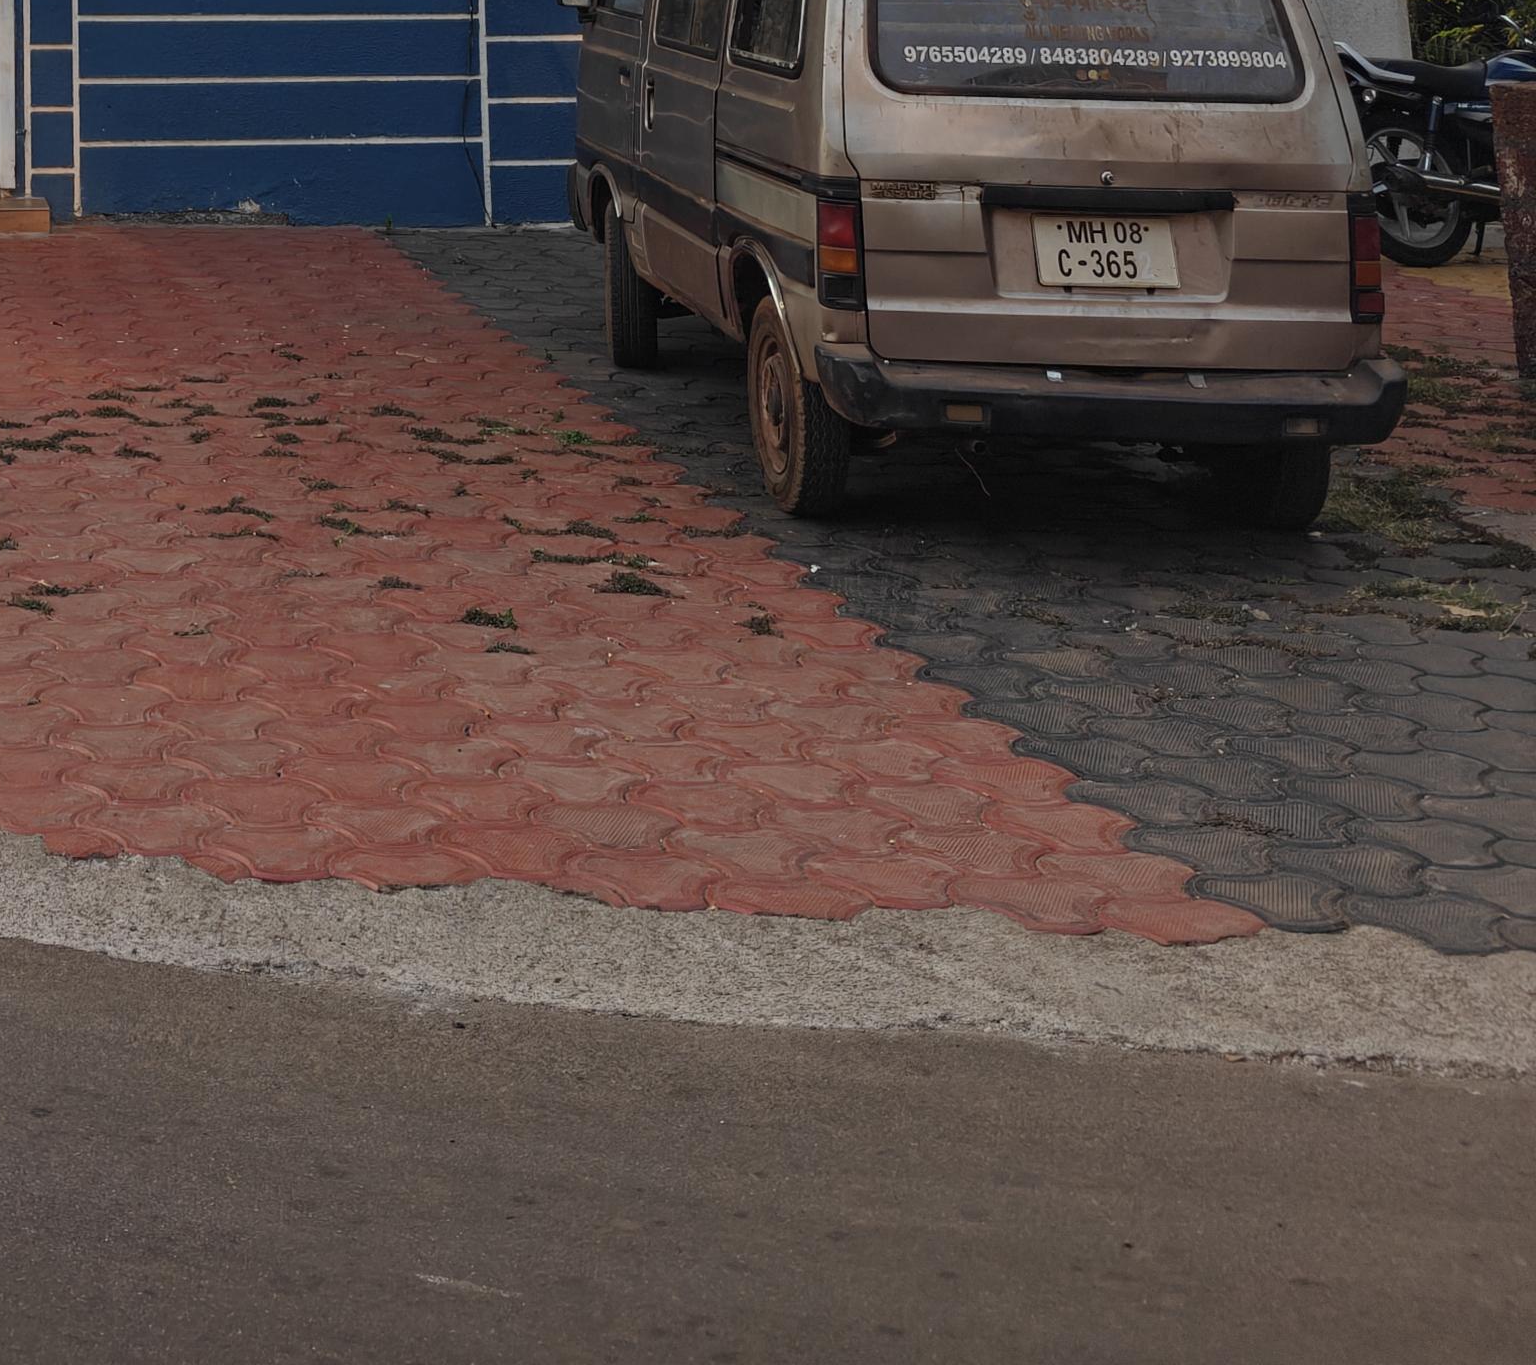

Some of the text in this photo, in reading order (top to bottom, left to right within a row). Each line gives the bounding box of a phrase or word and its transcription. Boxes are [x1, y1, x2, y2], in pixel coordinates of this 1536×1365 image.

[903, 45, 1027, 65] 9765504289
[1040, 47, 1160, 67] 8483804289
[1169, 49, 1287, 69] 9273899804
[1066, 221, 1143, 244] MH 08
